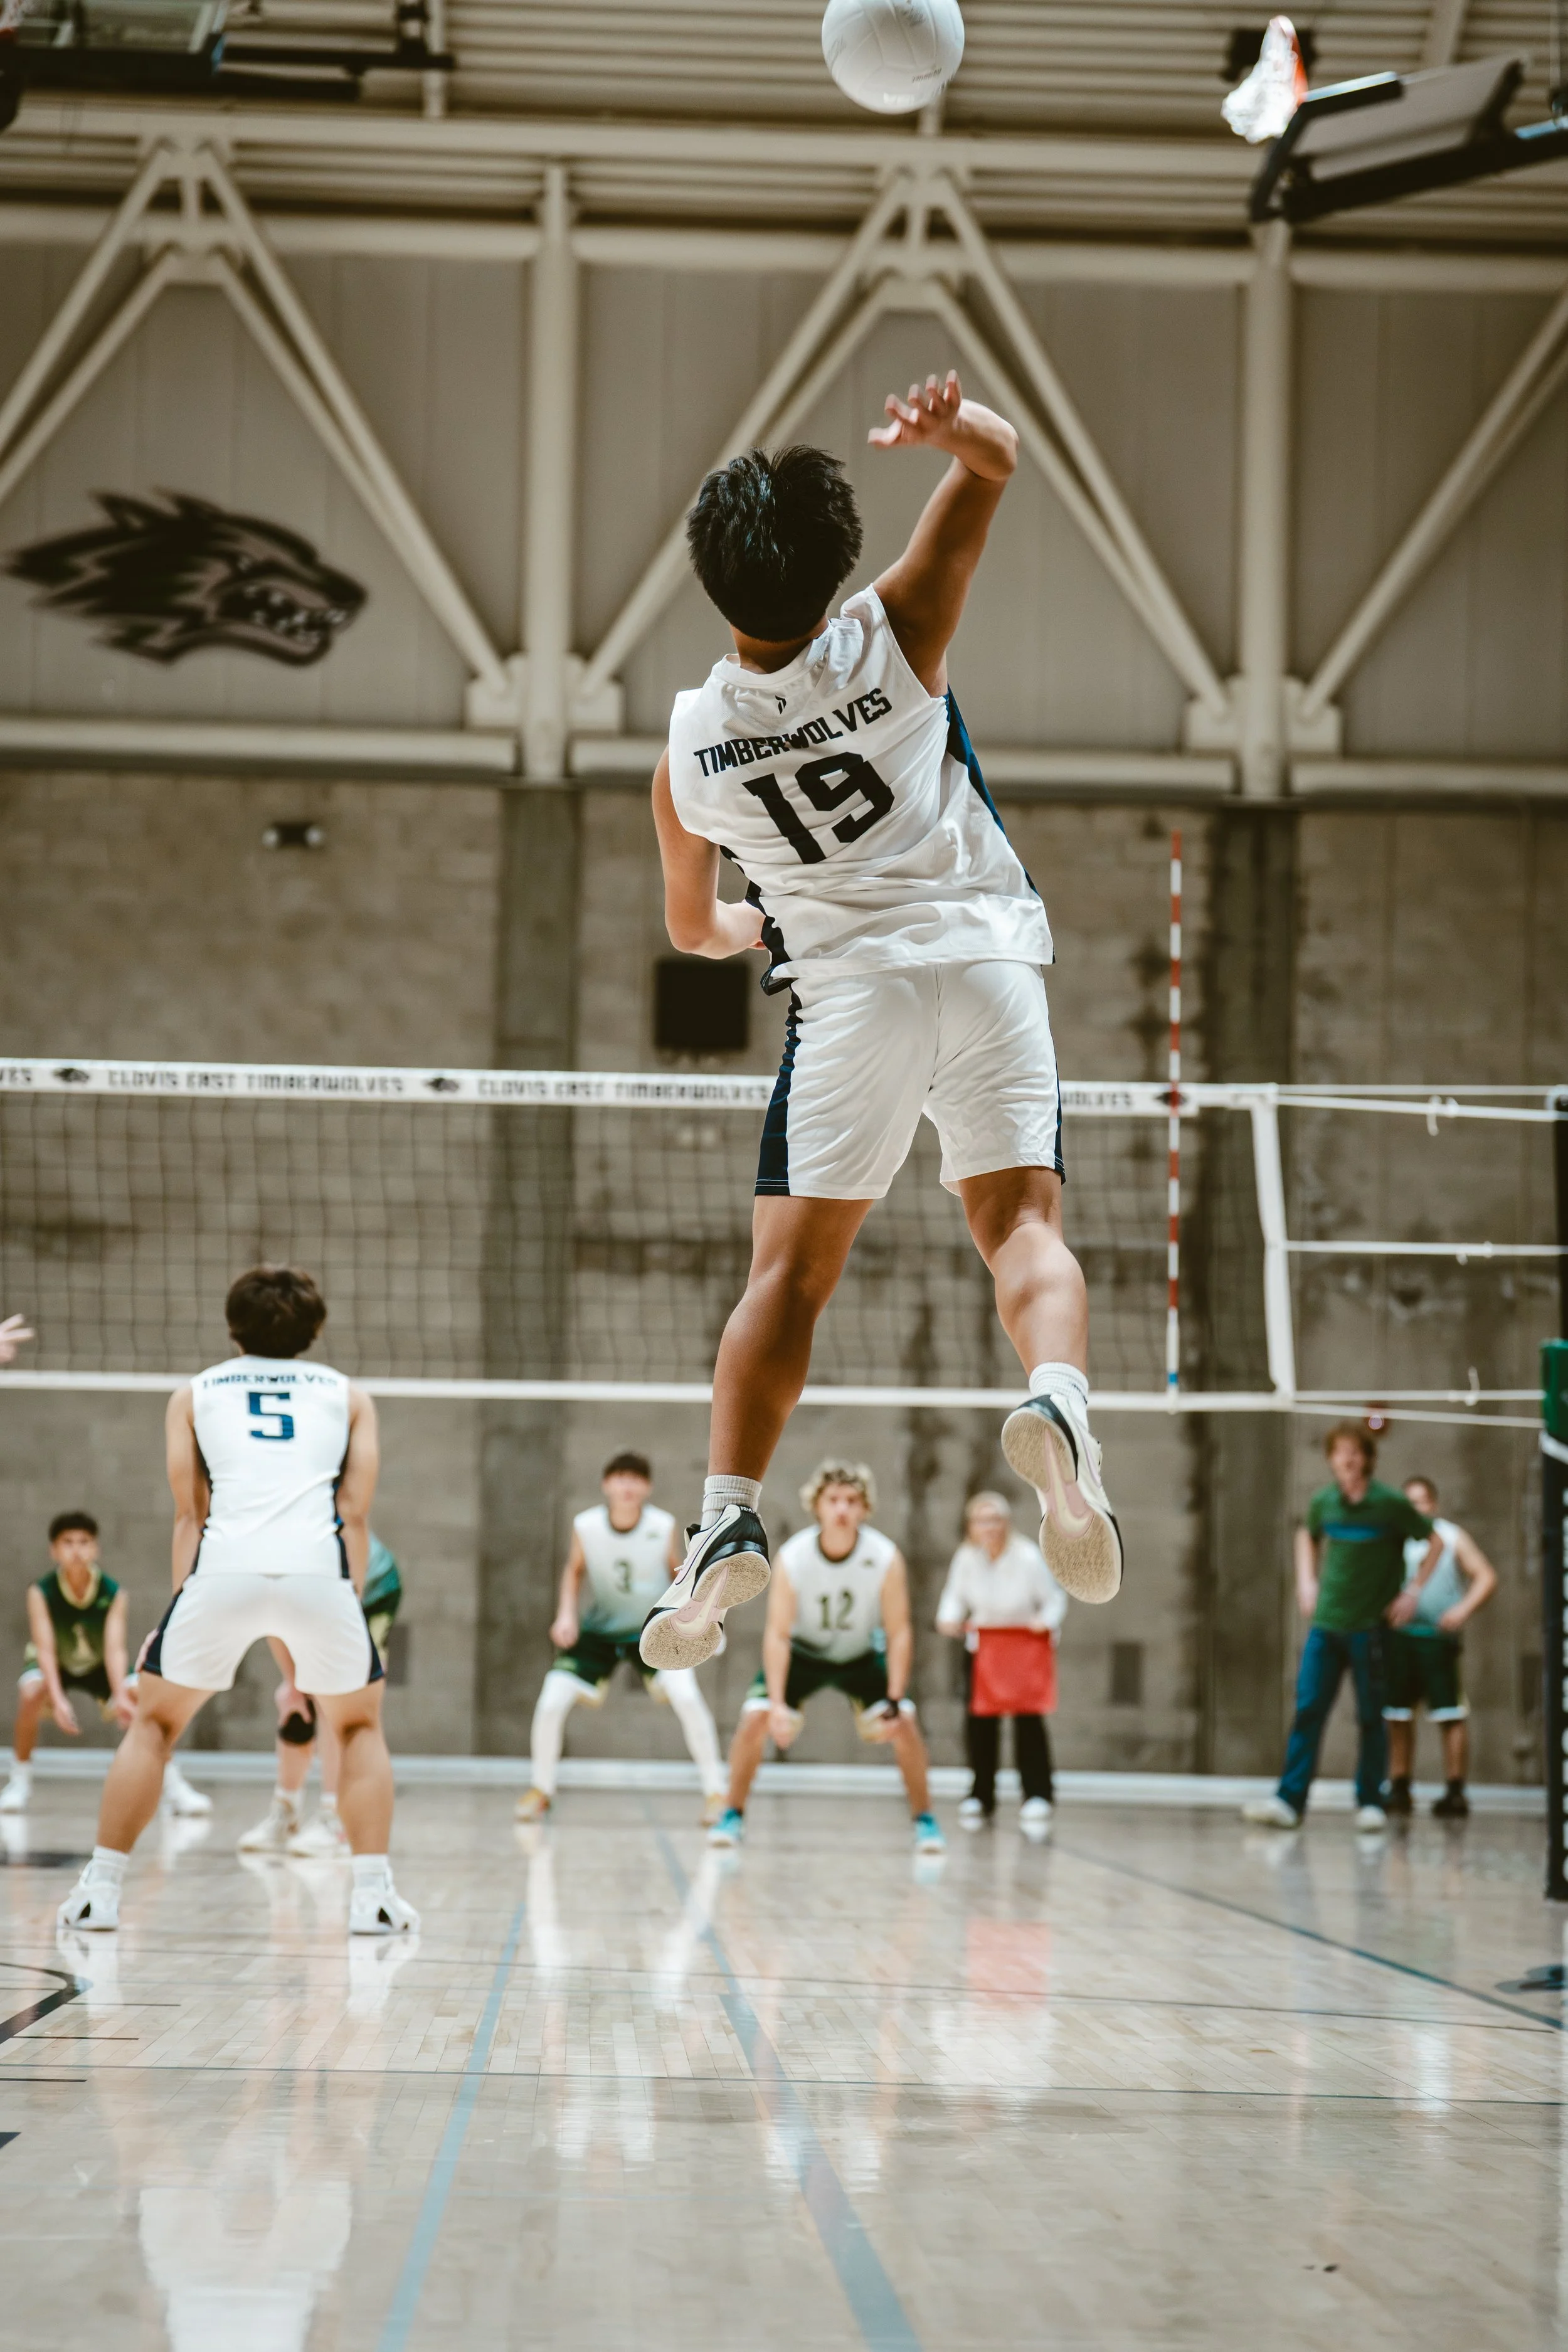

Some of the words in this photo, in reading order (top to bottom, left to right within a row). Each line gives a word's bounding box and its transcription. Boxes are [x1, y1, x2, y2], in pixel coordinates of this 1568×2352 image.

[693, 688, 893, 776] TIMBERWOLVES
[742, 751, 895, 864] 19
[109, 1070, 178, 1088] CLOVIS
[187, 1072, 236, 1089] EAST
[248, 1391, 294, 1441] 5
[614, 1560, 632, 1592] 3
[817, 1589, 855, 1631] 12
